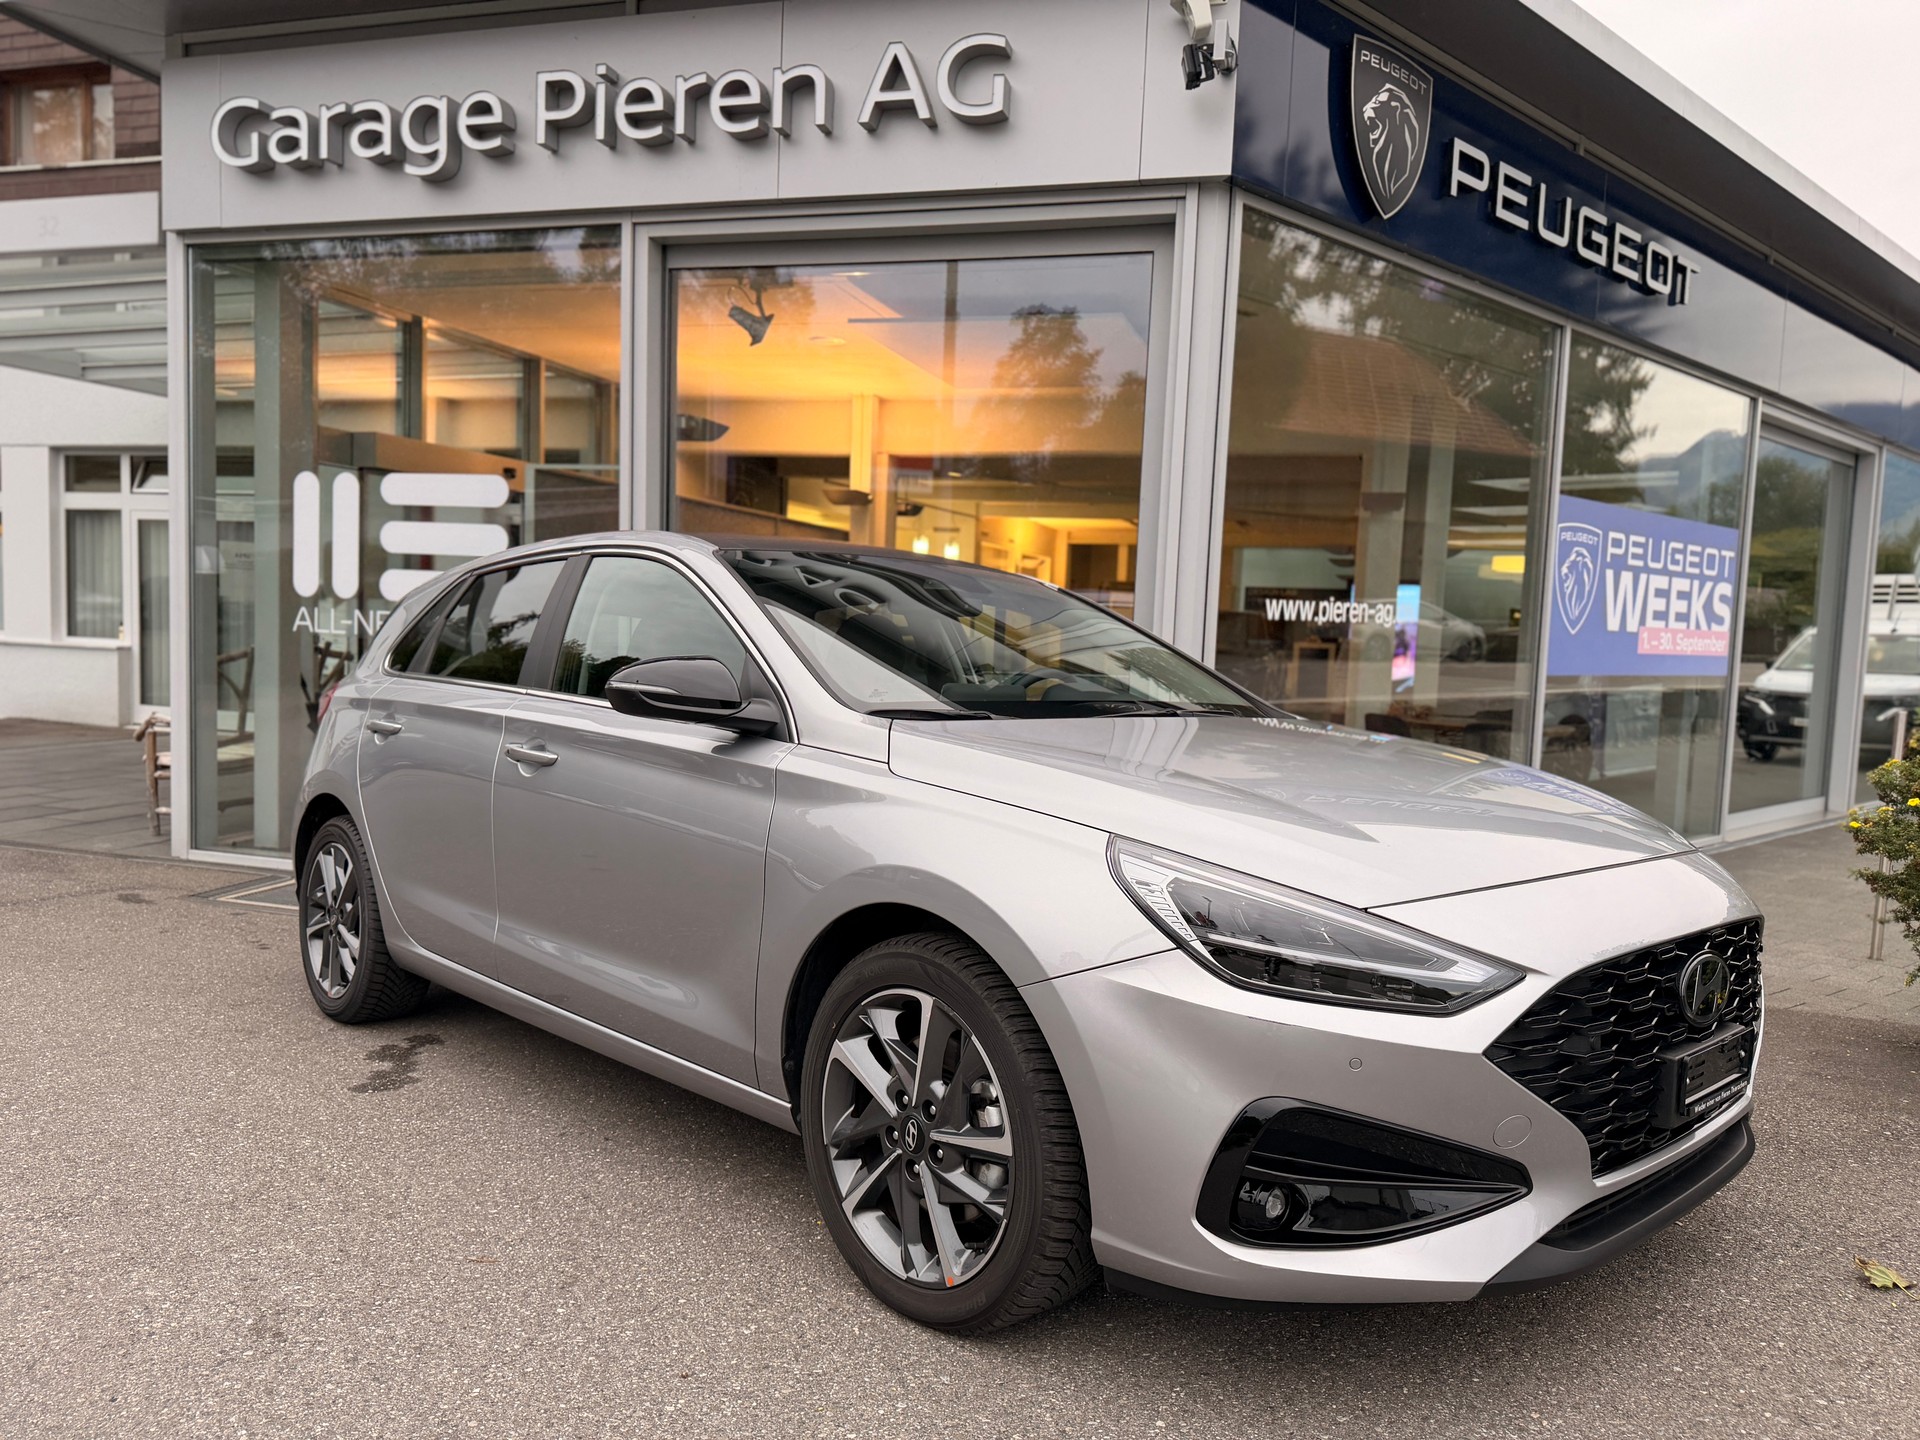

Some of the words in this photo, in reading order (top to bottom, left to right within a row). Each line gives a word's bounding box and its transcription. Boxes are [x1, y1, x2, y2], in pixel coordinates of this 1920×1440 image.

[1360, 50, 1427, 95] PEUGEOT
[210, 88, 513, 180] Garage
[536, 62, 832, 151] Pieren
[857, 33, 1012, 131] AG
[1450, 137, 1700, 305] PEUGEOT
[1560, 531, 1599, 545] PEUGEOT
[1606, 531, 1735, 578] PEUGEOT
[1605, 568, 1733, 632] WEEKS
[1676, 632, 1727, 654] September
